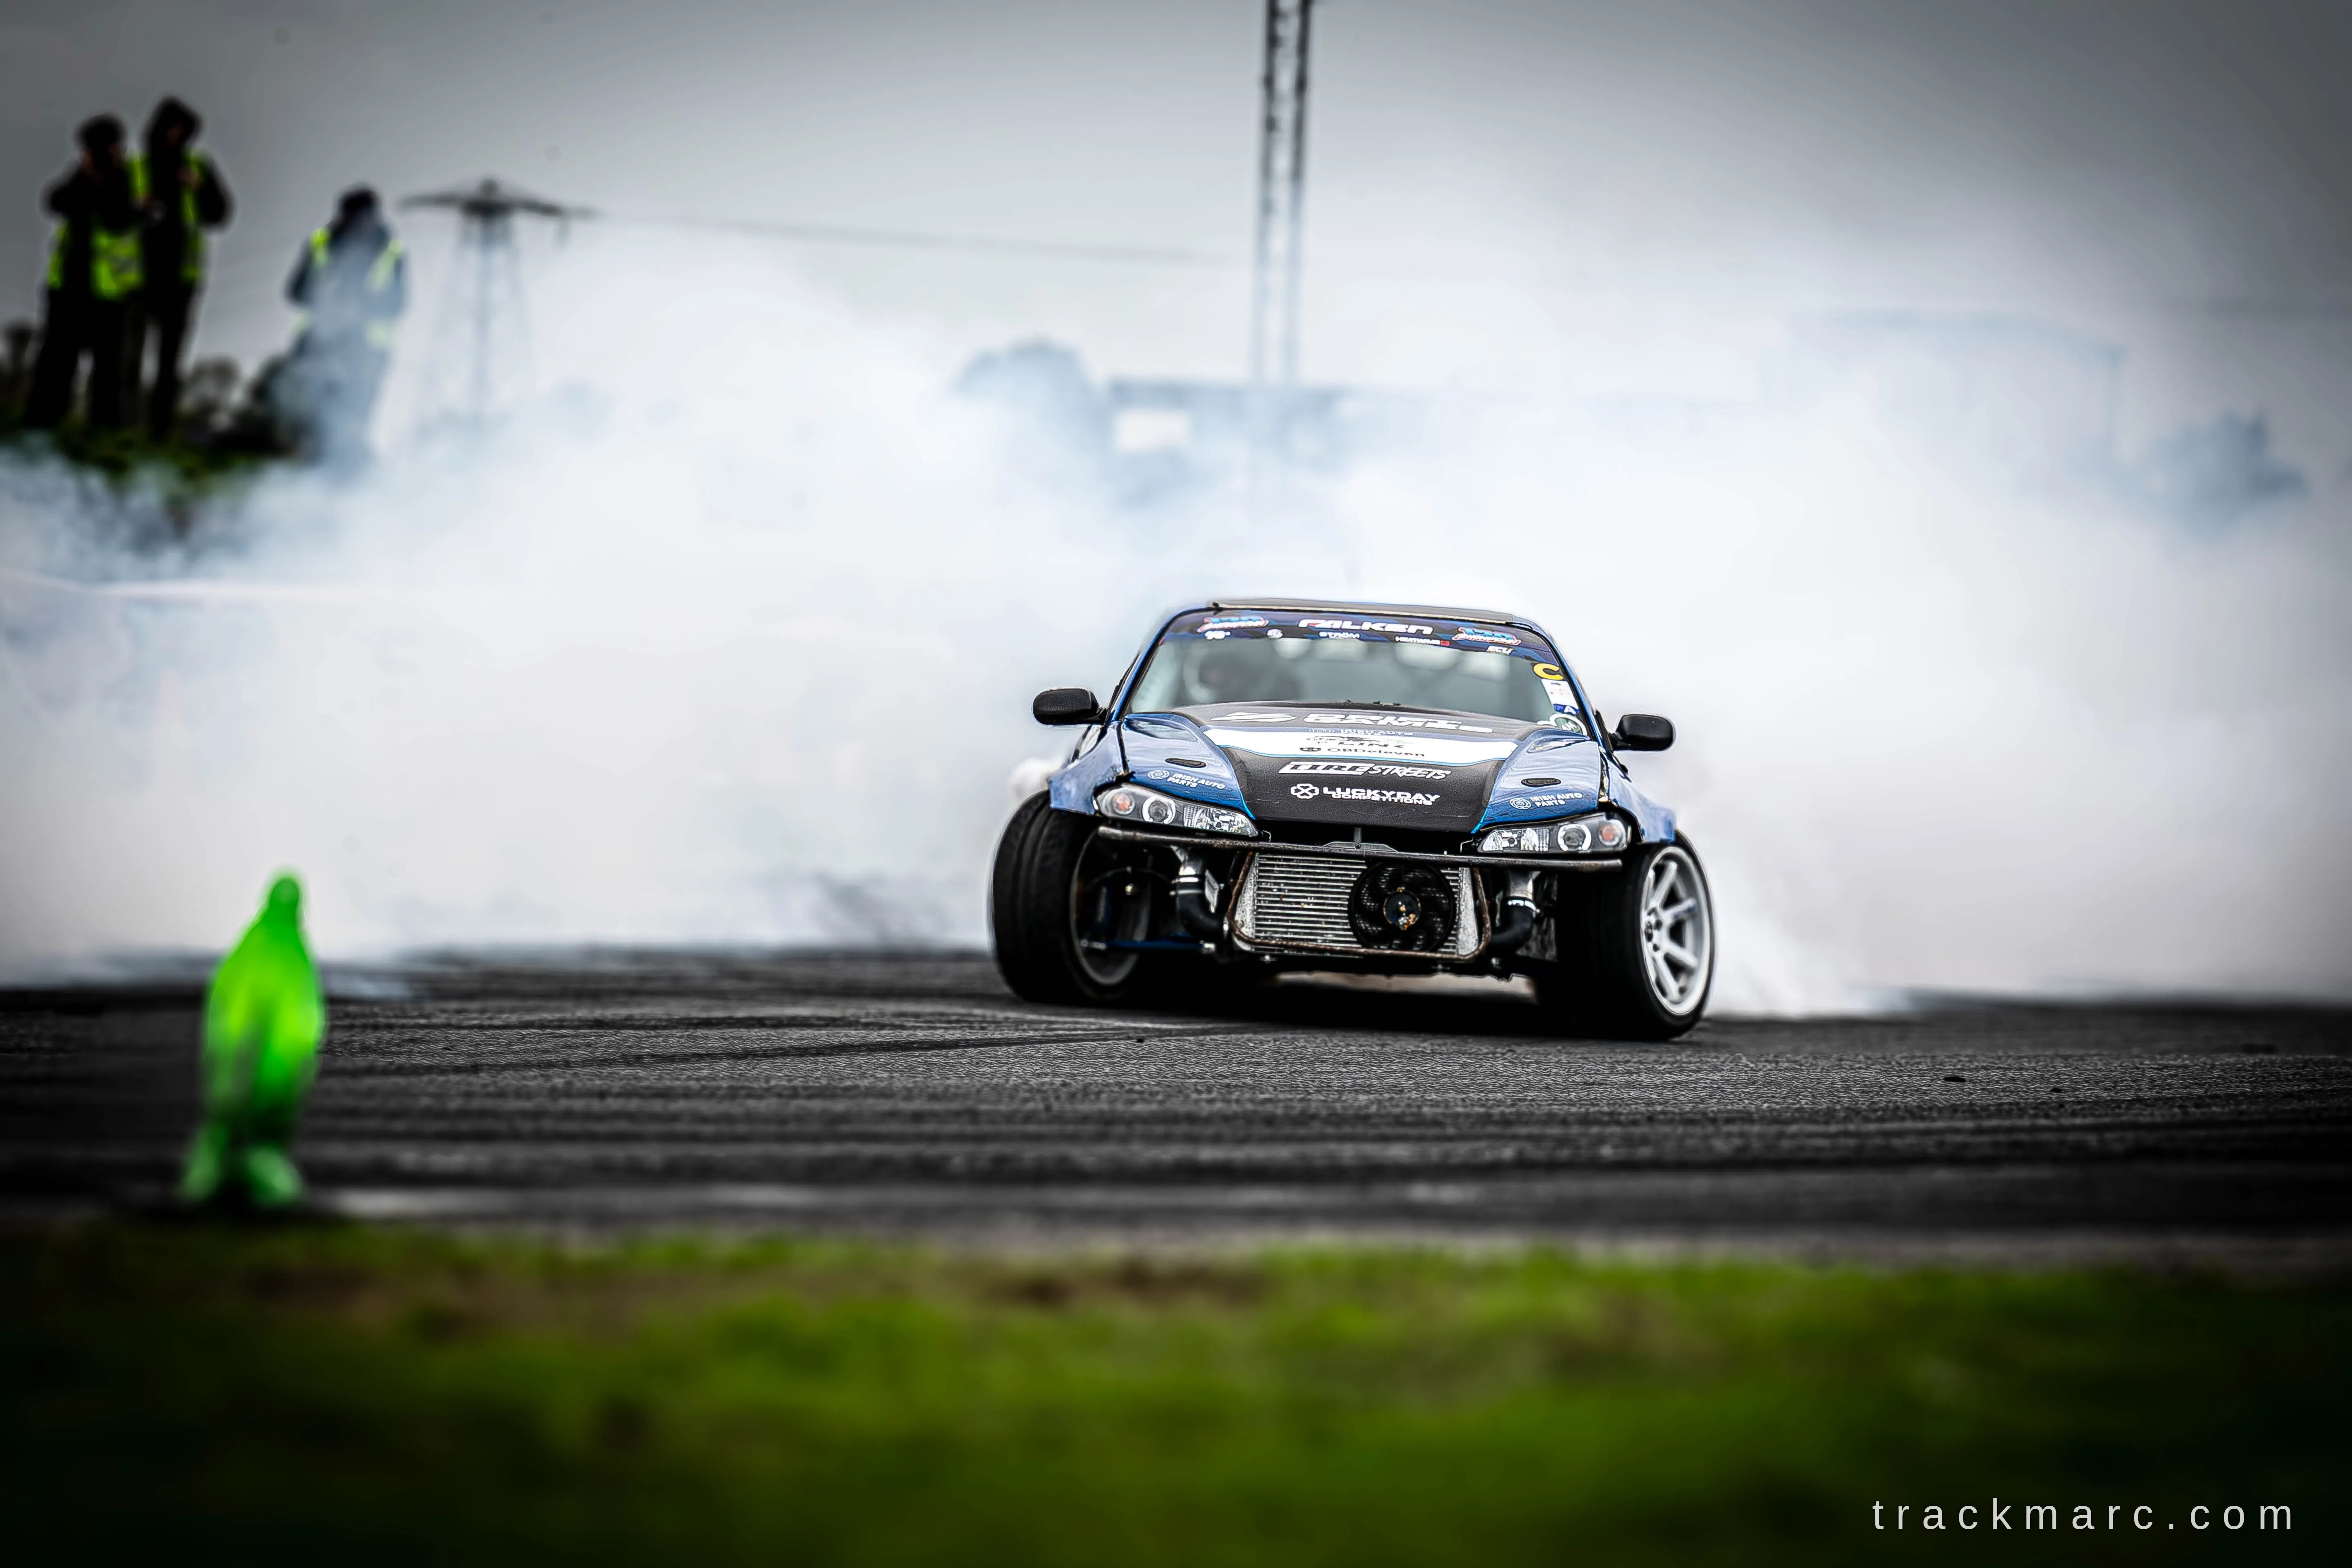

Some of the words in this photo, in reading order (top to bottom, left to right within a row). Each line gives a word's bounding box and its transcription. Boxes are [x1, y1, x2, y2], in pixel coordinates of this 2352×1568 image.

[1533, 663, 1564, 680] C
[1167, 777, 1198, 787] PARTS
[1172, 773, 1198, 783] IRISH
[1198, 779, 1225, 789] AUTO
[1323, 787, 1441, 802] LUCKYDAY
